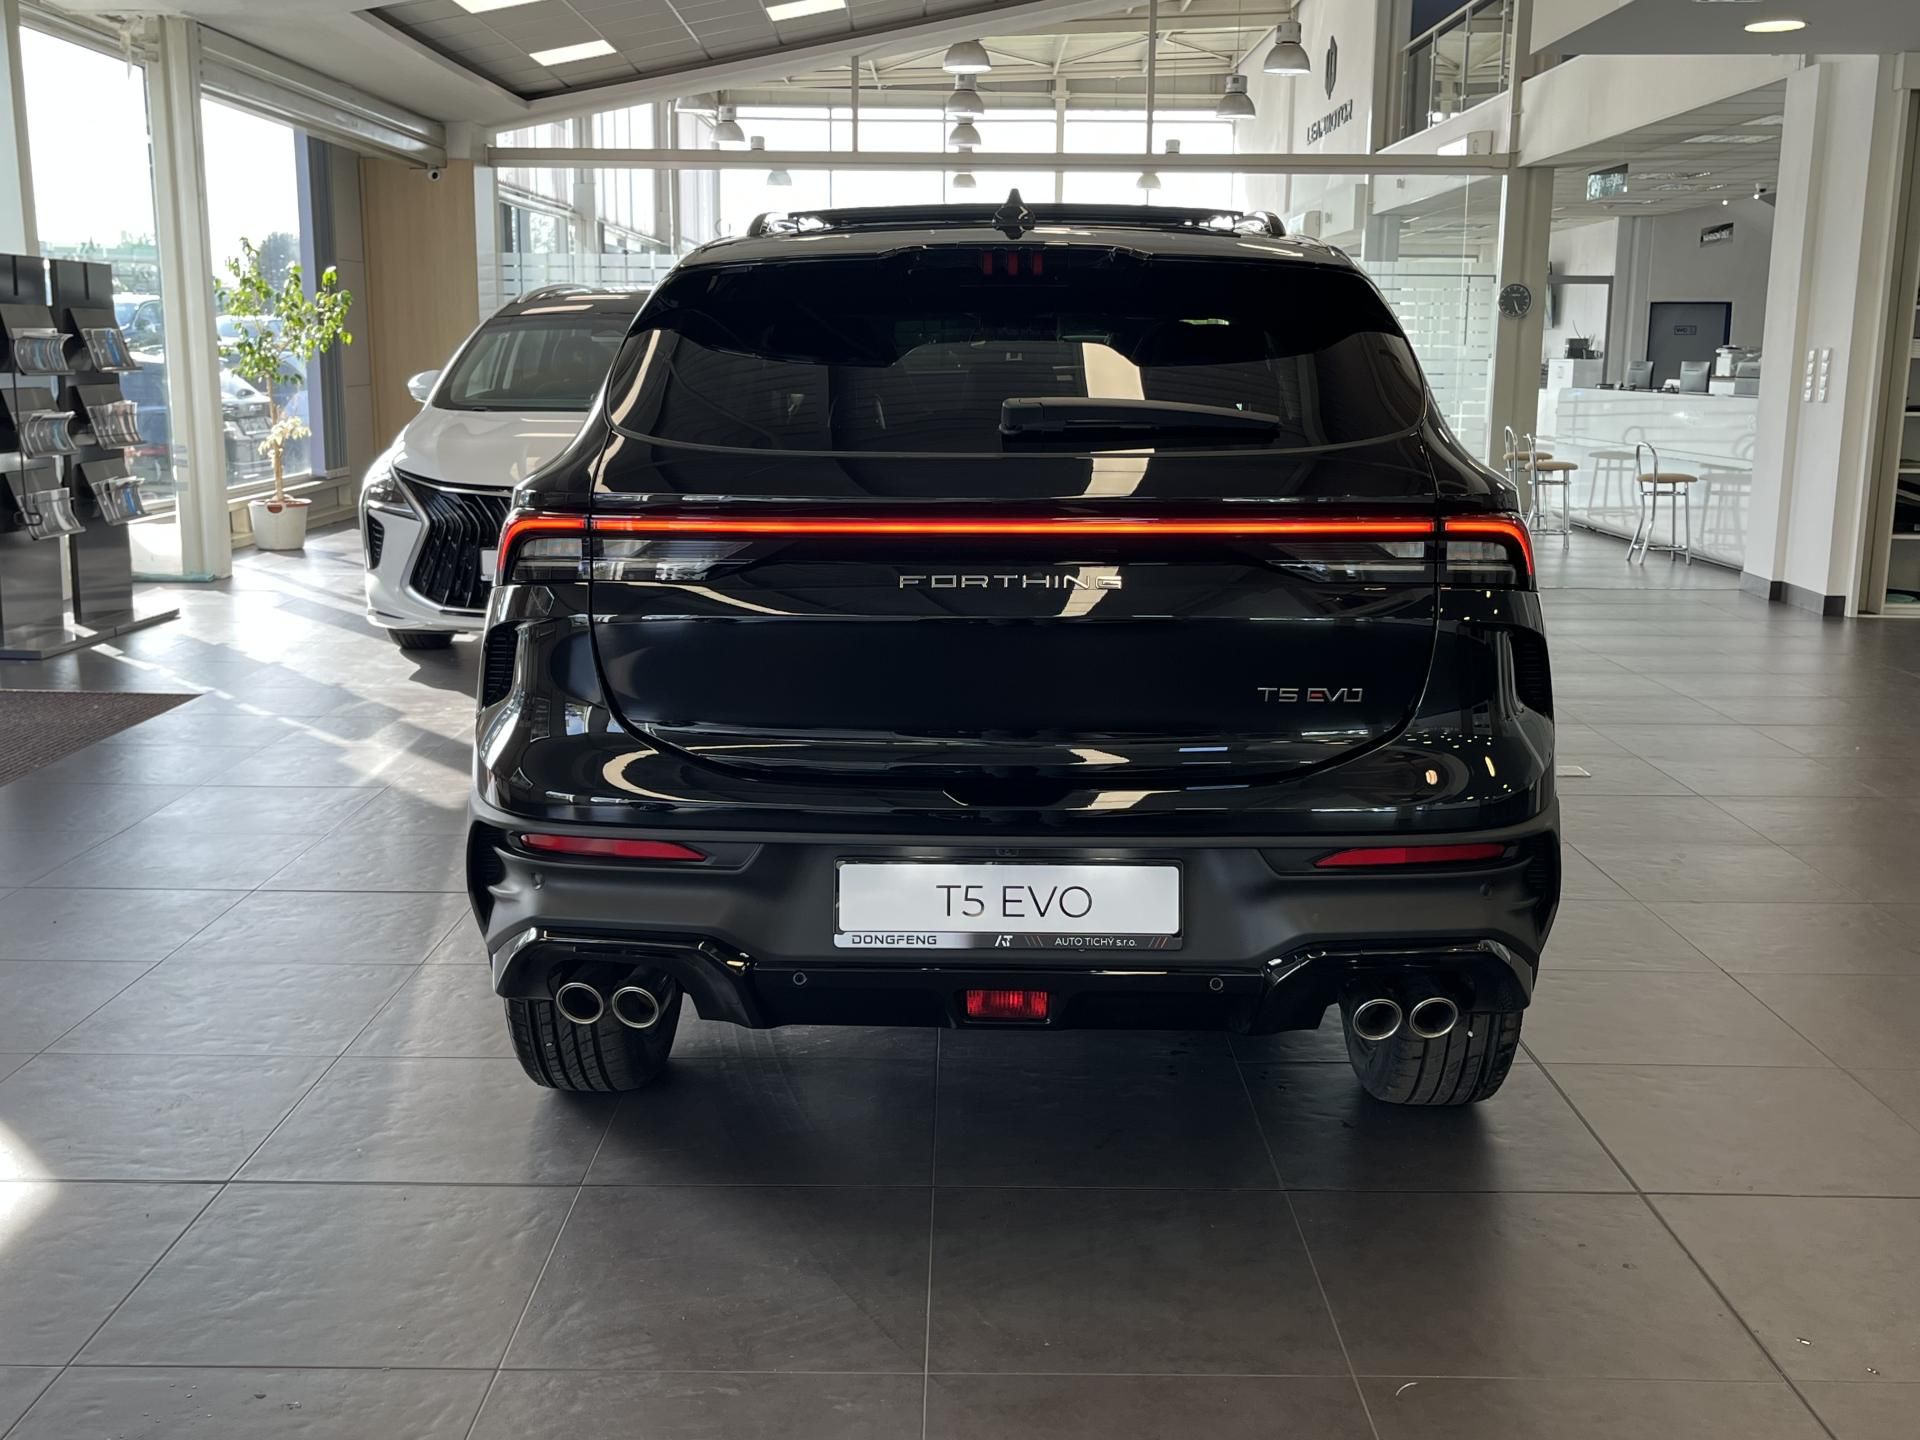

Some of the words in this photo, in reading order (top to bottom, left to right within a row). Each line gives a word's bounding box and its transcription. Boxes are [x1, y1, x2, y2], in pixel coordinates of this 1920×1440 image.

[898, 574, 1122, 590] FORTHING
[1257, 687, 1299, 702] T5
[1307, 687, 1363, 702] EVO
[936, 884, 985, 918] T5
[1002, 885, 1093, 918] EVO
[851, 934, 938, 945] DONGFENG
[1054, 937, 1083, 946] AUTO
[1085, 936, 1114, 946] TICHÝ
[1116, 938, 1138, 947] s.r.o.
